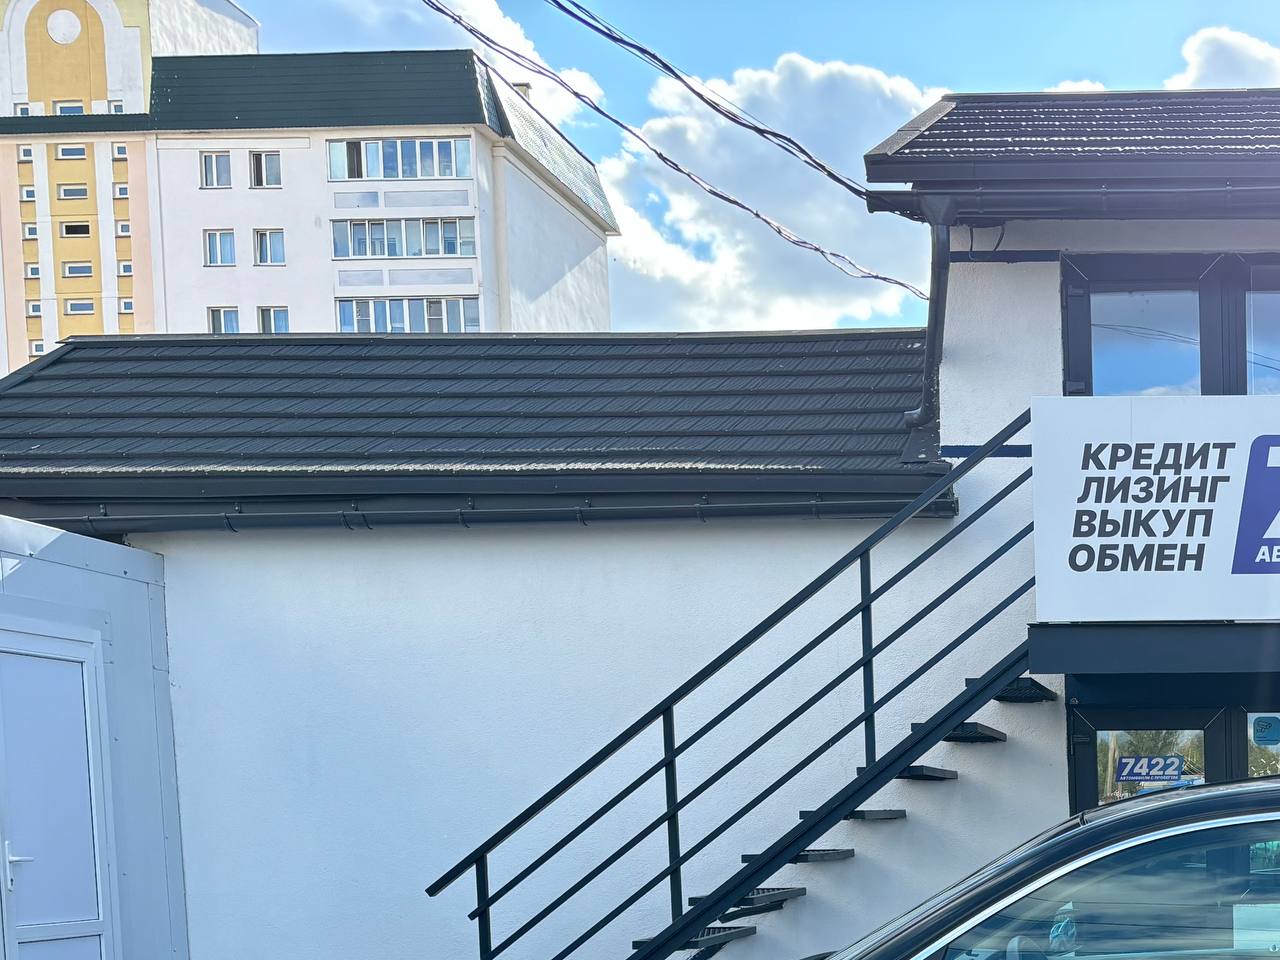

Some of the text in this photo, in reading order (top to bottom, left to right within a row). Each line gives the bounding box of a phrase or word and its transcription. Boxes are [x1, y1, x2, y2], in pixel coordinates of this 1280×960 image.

[1081, 442, 1236, 475] КРЕДИТ
[1076, 476, 1230, 504] ЛИЗИНГ
[1072, 508, 1214, 538] ВЫКУП
[1068, 543, 1206, 572] ОБМЕН
[1121, 757, 1180, 776] 7422
